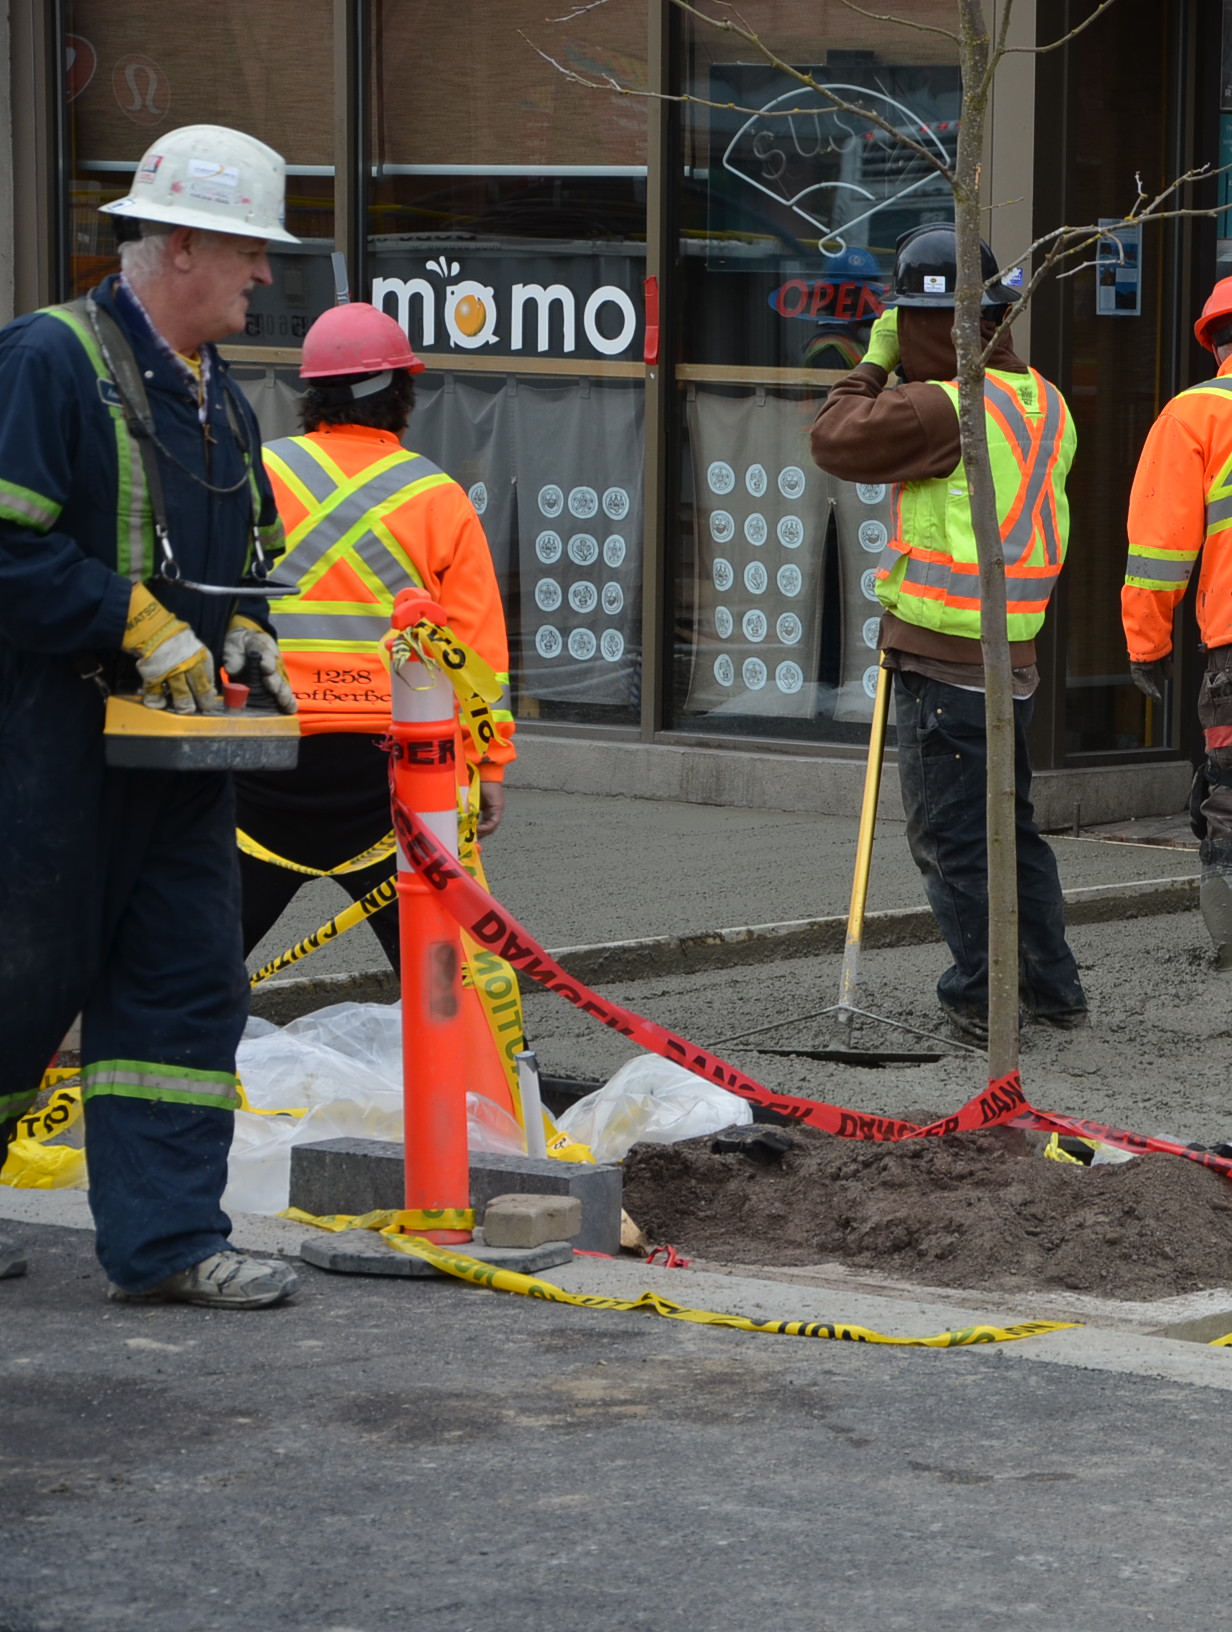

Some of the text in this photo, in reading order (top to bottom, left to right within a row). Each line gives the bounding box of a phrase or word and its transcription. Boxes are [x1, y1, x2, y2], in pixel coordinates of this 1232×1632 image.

[371, 276, 637, 355] momo
[776, 279, 890, 320] OPEN
[312, 669, 372, 684] 1258
